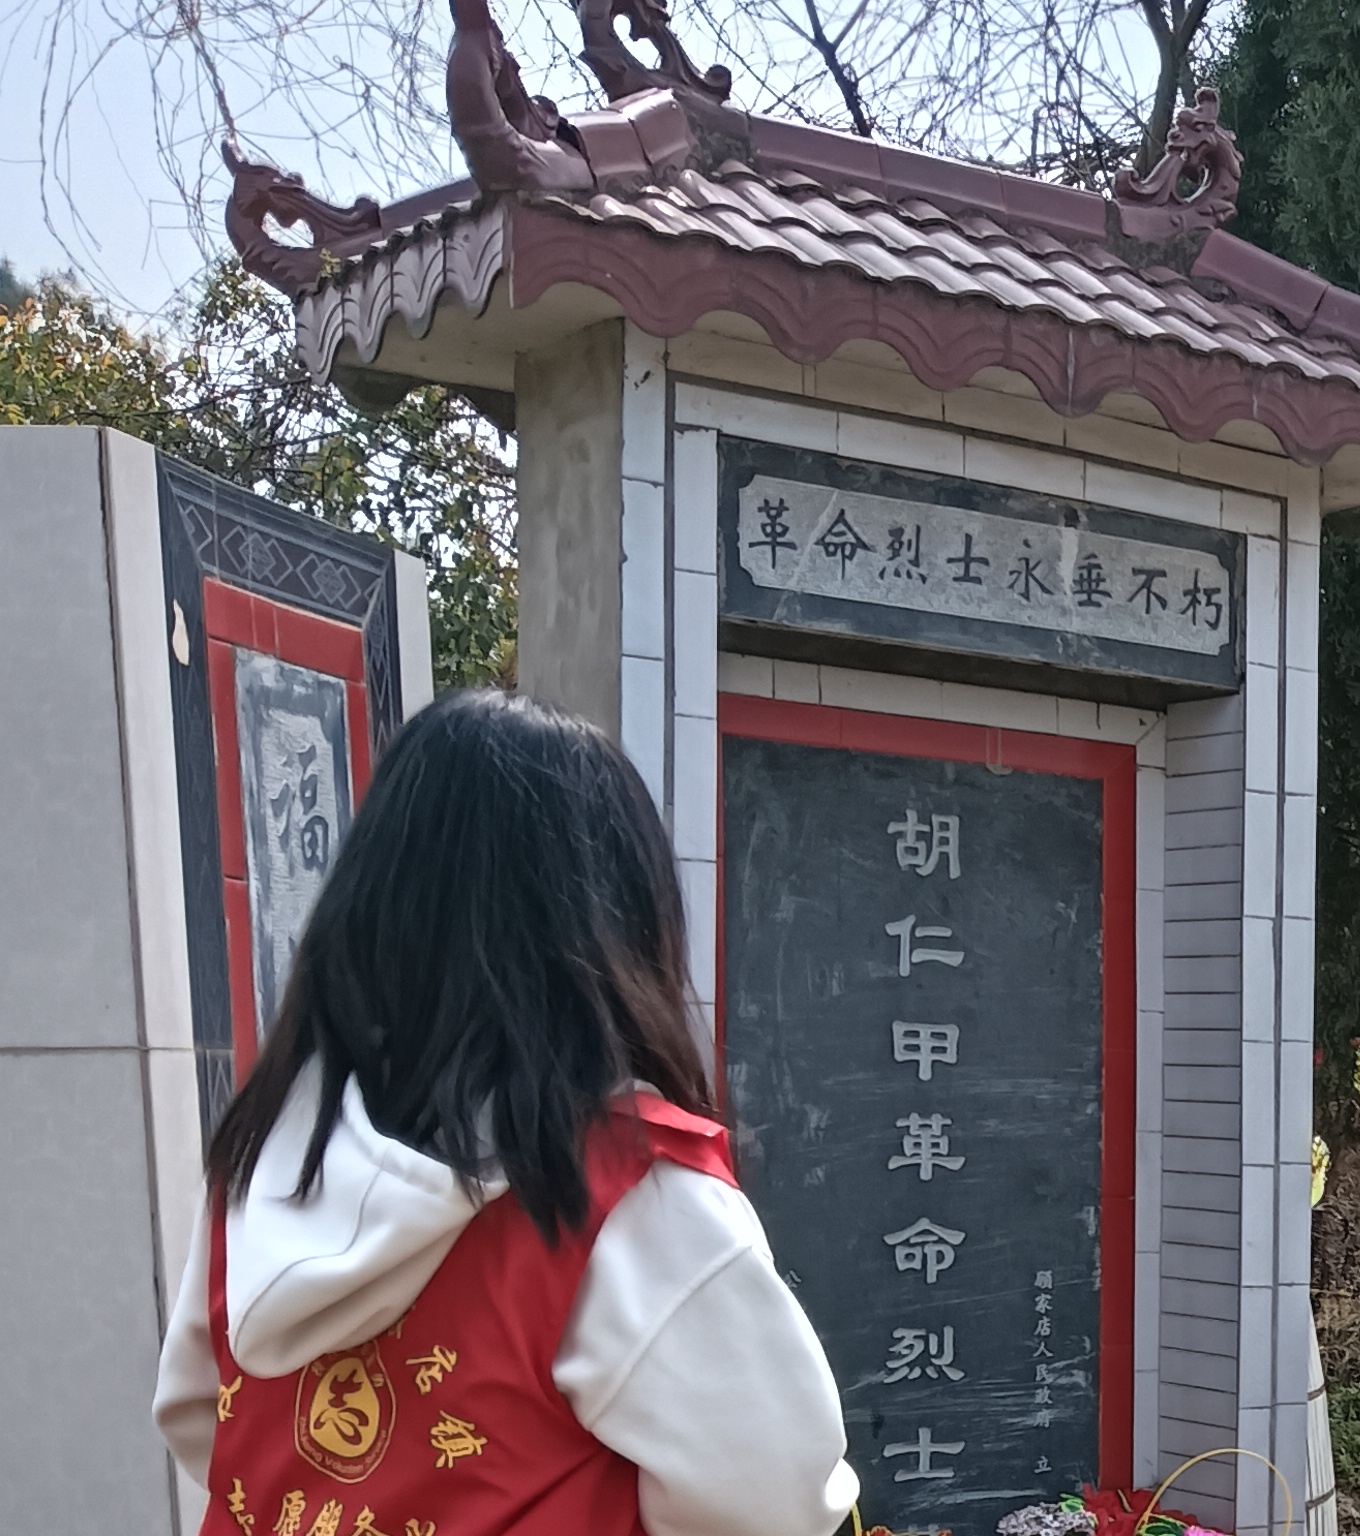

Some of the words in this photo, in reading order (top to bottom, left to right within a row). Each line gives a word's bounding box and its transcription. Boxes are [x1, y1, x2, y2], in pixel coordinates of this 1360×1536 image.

[748, 497, 1224, 632] 革命烈士永垂不朽
